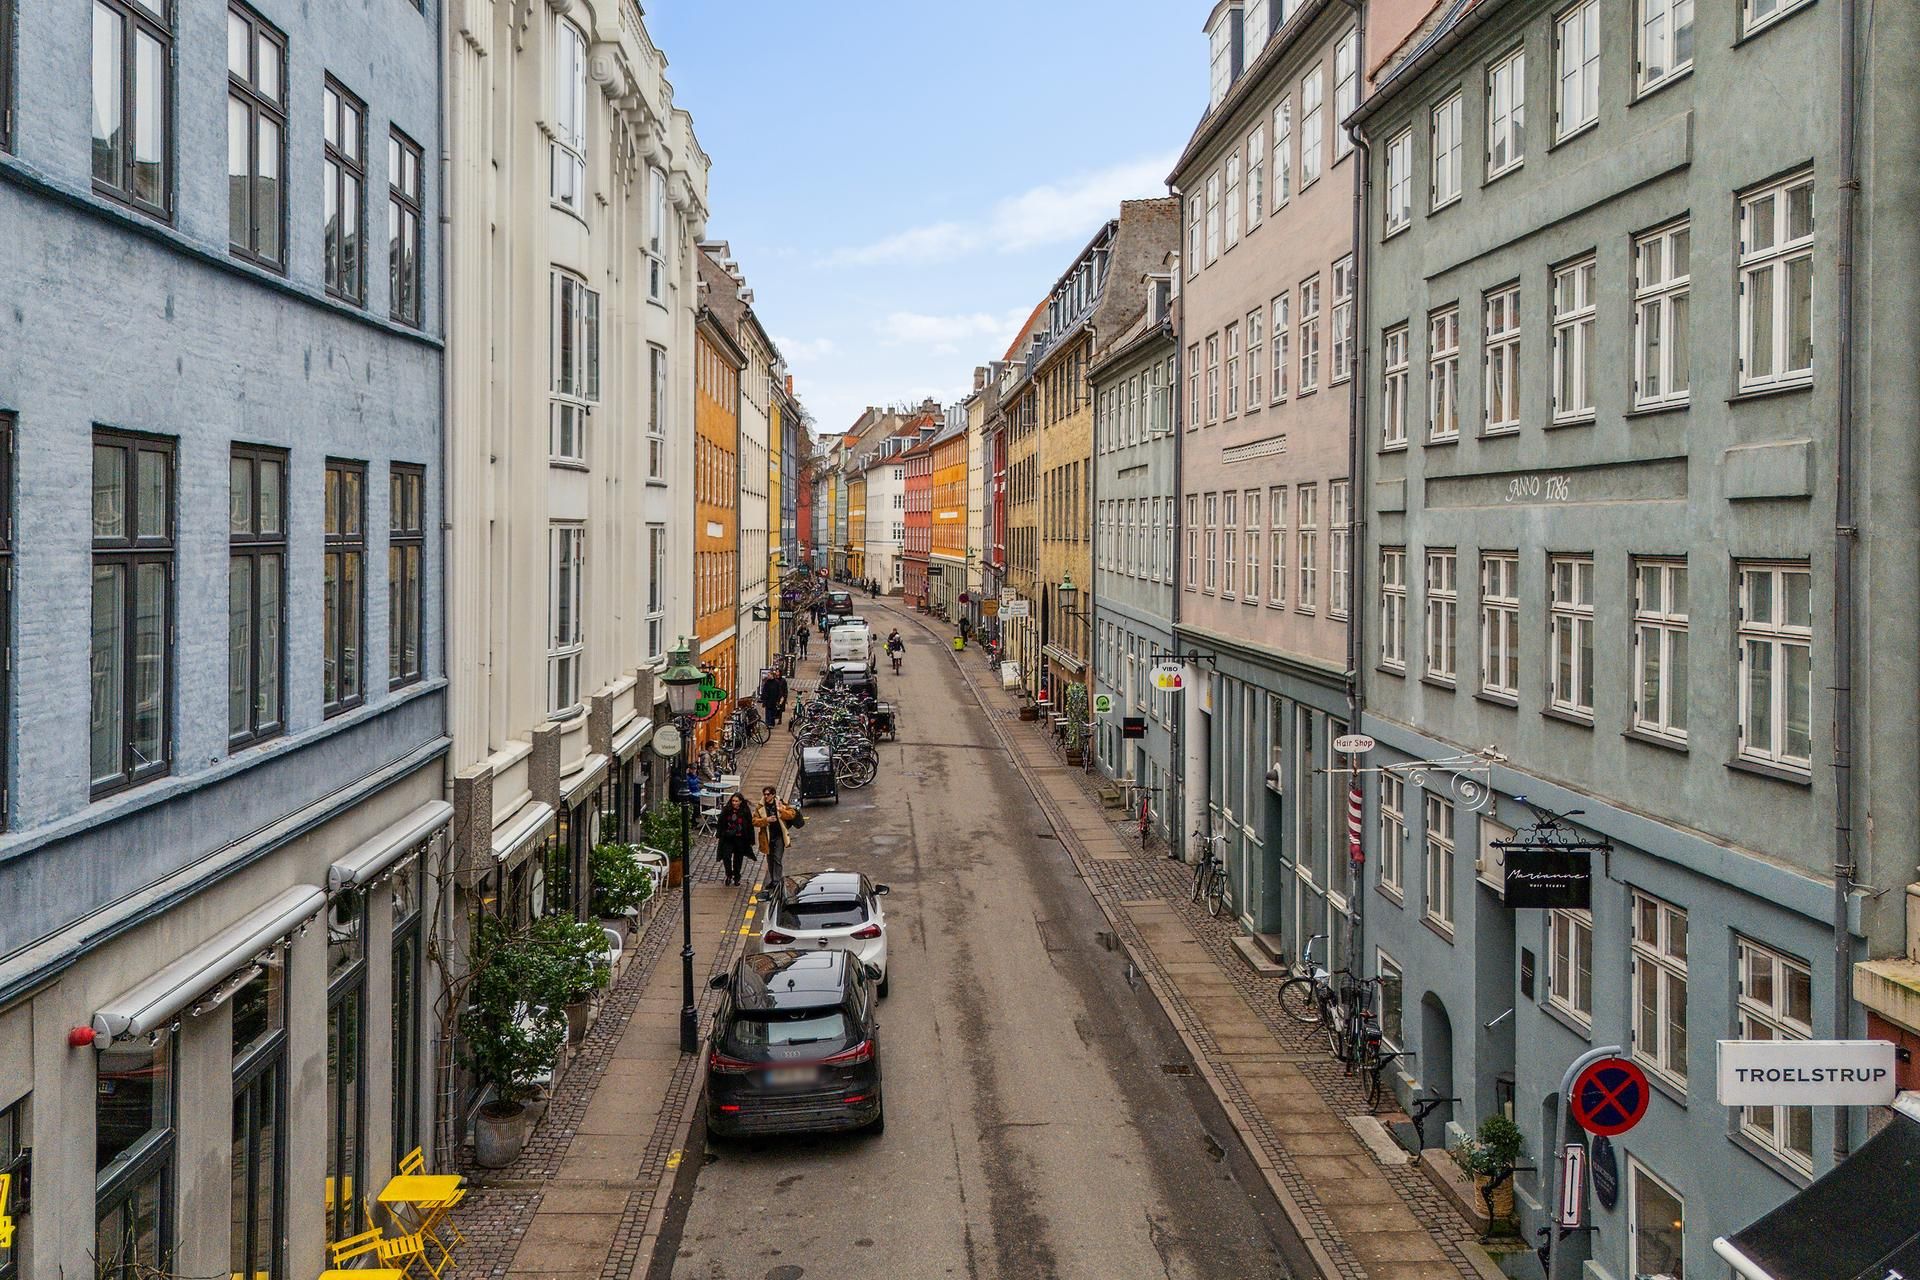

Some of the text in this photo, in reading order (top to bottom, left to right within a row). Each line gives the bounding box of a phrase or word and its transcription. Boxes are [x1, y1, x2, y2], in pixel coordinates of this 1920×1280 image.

[1505, 475, 1571, 502] ANNO 1786
[703, 690, 722, 699] NYE
[695, 702, 709, 712] EN
[1336, 739, 1373, 749] Hair Shop
[1735, 1068, 1887, 1082] TROELSTRUP
